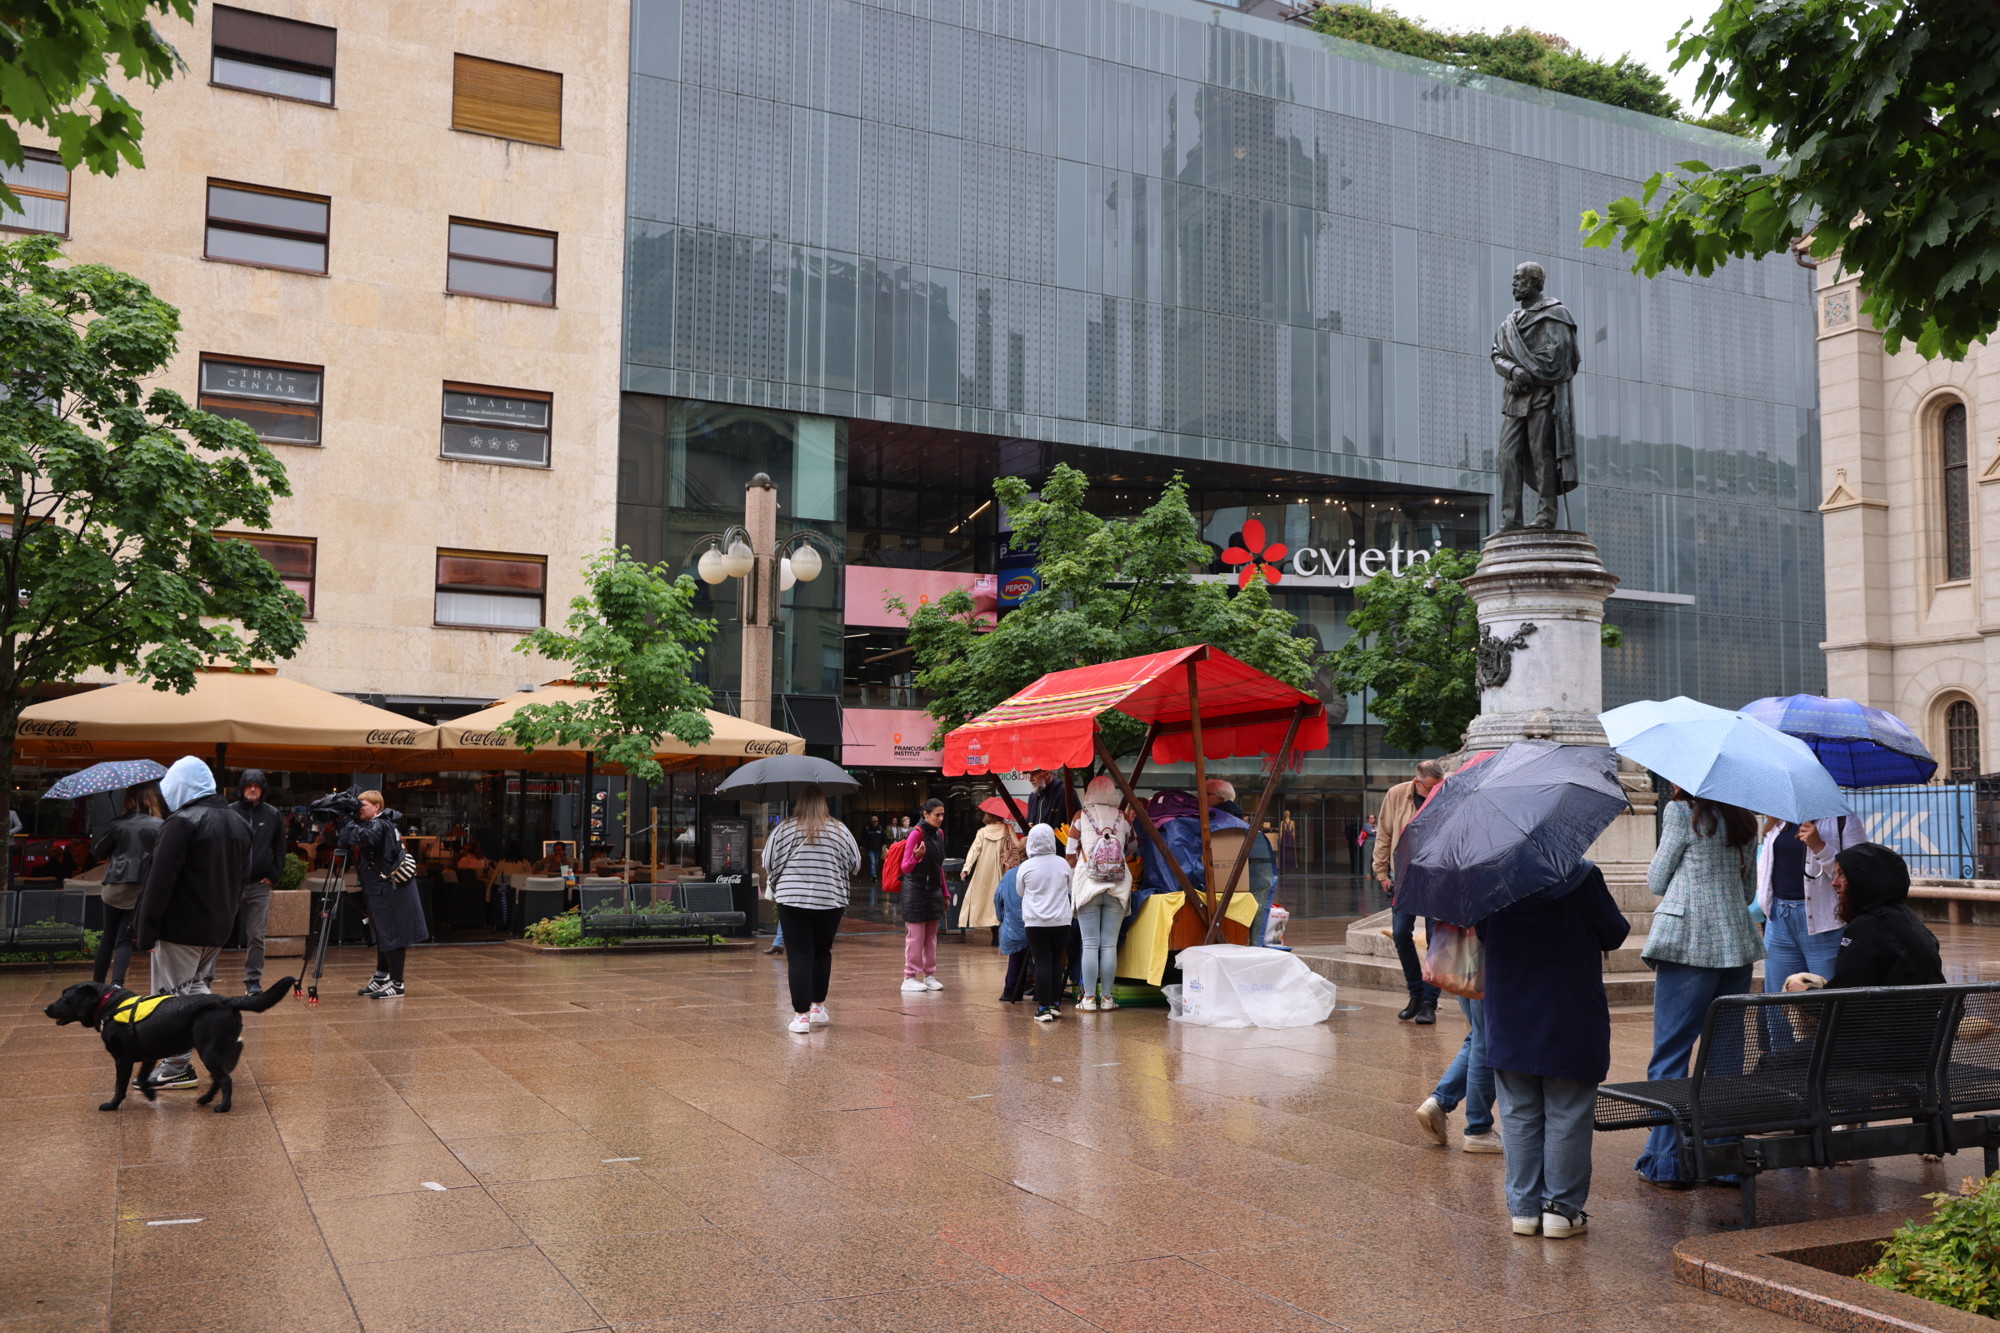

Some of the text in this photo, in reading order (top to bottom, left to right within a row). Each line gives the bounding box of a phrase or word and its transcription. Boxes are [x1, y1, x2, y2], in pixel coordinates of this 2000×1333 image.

[241, 368, 283, 381] THAI
[227, 378, 295, 393] CENTAR
[466, 397, 526, 410] MALI
[1005, 583, 1030, 593] PEPCO
[18, 718, 80, 737] Coca-Cola
[366, 729, 416, 746] Coca-Cola
[459, 730, 511, 747] Coca-Cola
[744, 739, 787, 755] Coca-Cola
[715, 874, 743, 884] Coca-Cola
